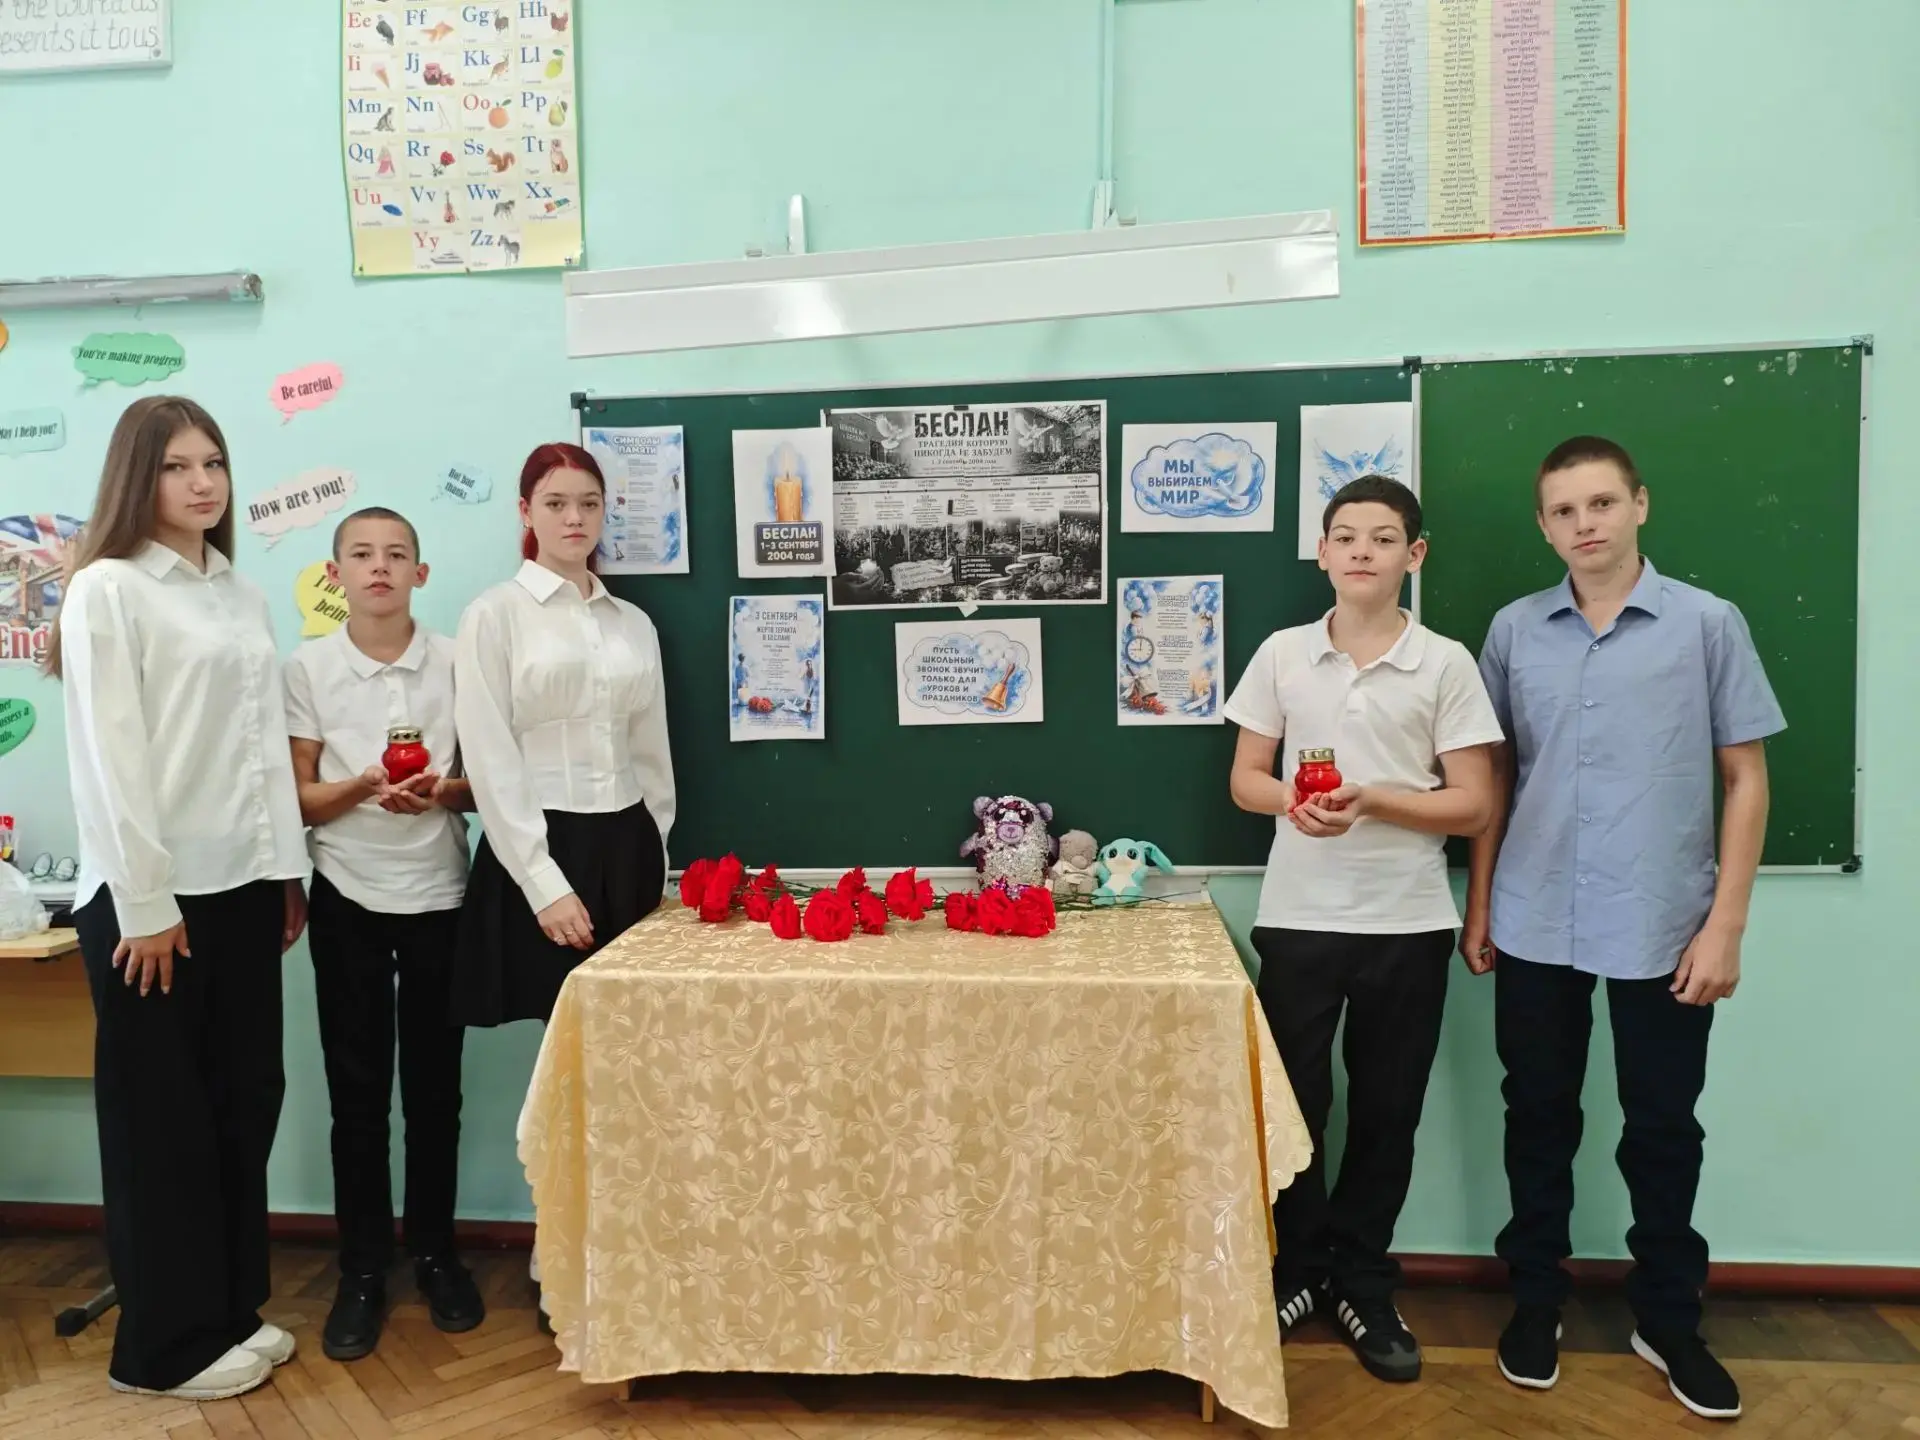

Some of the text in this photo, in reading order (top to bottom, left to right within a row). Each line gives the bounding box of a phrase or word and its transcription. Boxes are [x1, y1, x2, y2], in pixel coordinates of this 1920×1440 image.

[347, 1, 548, 28] Ee Ff Gg Hh
[347, 46, 540, 73] Ii Jj Kk Ll
[347, 91, 548, 114] Mm Nn Oo Pp
[348, 136, 544, 164] Qq Rr Ss Tt
[353, 181, 553, 205] Uu Vv Ww Xx
[414, 229, 494, 252] Yy Zz
[77, 347, 182, 368] You're making progress
[281, 376, 333, 401] Be careful
[914, 411, 1009, 438] БЕСЛАН
[618, 445, 657, 455] ПАМЯТИ
[918, 439, 1008, 449] ТРАГЕДИЯ КОТОРУЮ
[914, 449, 956, 458] НИКОГДА
[972, 448, 1012, 456] ЗАБУДЕМ
[1164, 460, 1194, 473] МЫ
[1148, 476, 1212, 487] ВЫБИРАЕМ
[248, 476, 346, 523] How are you!
[1160, 490, 1200, 504] МИР
[762, 527, 817, 540] БЕСЛАН
[778, 540, 820, 549] СЕНТЯБРЯ
[767, 551, 793, 560] 2004
[313, 598, 351, 623] bein
[761, 611, 798, 621] СЕНТЯБРЯ
[932, 646, 960, 655] ПУСТЬ
[922, 656, 974, 664] ШКОЛЬНЫЙ
[922, 694, 978, 702] ПРАЗДНИКОВ
